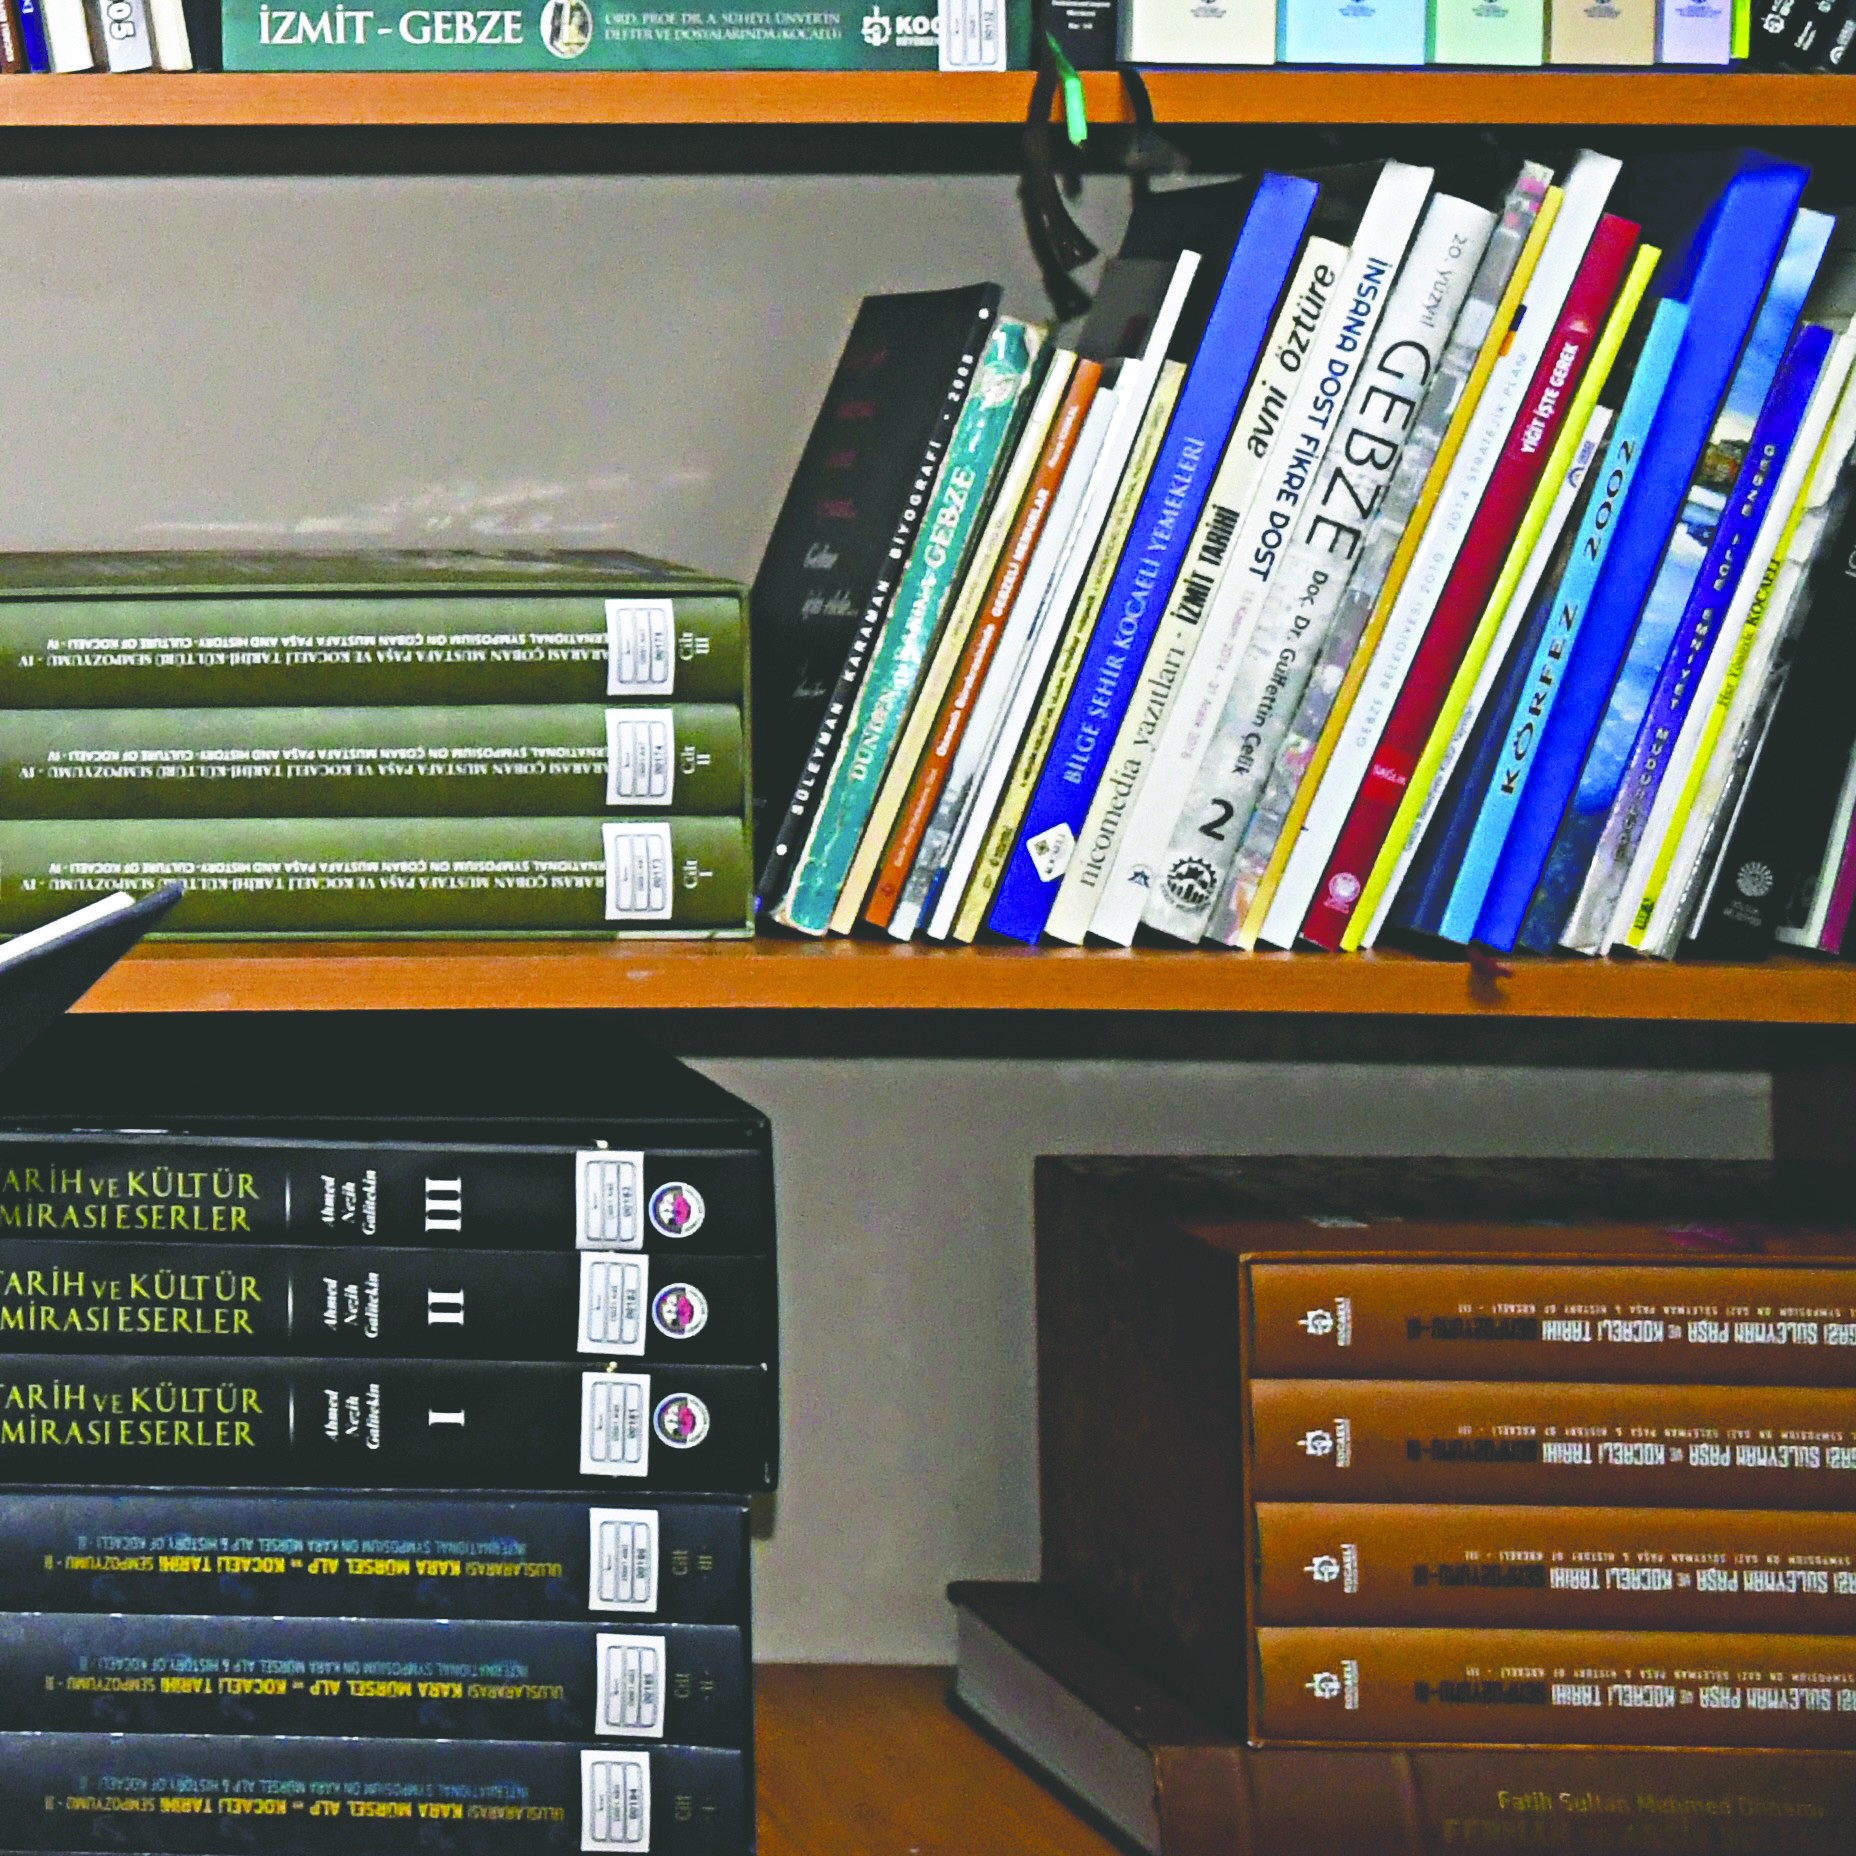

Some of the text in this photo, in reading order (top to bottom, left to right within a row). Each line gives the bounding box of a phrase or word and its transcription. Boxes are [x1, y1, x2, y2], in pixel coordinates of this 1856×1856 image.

[259, 4, 523, 44] İZMİT GEBZE
[1237, 259, 1337, 460] avni öztüre
[1246, 255, 1392, 583] İNSANA DOST FİKRE DOST
[1306, 330, 1437, 563] GEBZE
[1061, 434, 1205, 785] BİLGE ŞEHİR KOCAELİ YEMEKLERİ
[1497, 436, 1637, 796] KÖRFEZ 2002
[1071, 502, 1241, 888] nicomedia yazıtları İZMİT TARİHİ
[1198, 798, 1236, 840] 2
[425, 1177, 462, 1232] III
[92, 1279, 122, 1300] VE
[129, 1267, 262, 1302] KÜLTÜR
[428, 1288, 464, 1325] II
[0, 1299, 255, 1335] MİRASI ESERLER
[92, 1393, 123, 1414] VE
[131, 1380, 264, 1415] KÜLTÜR
[1, 1412, 255, 1448] MİRASI ESERLER
